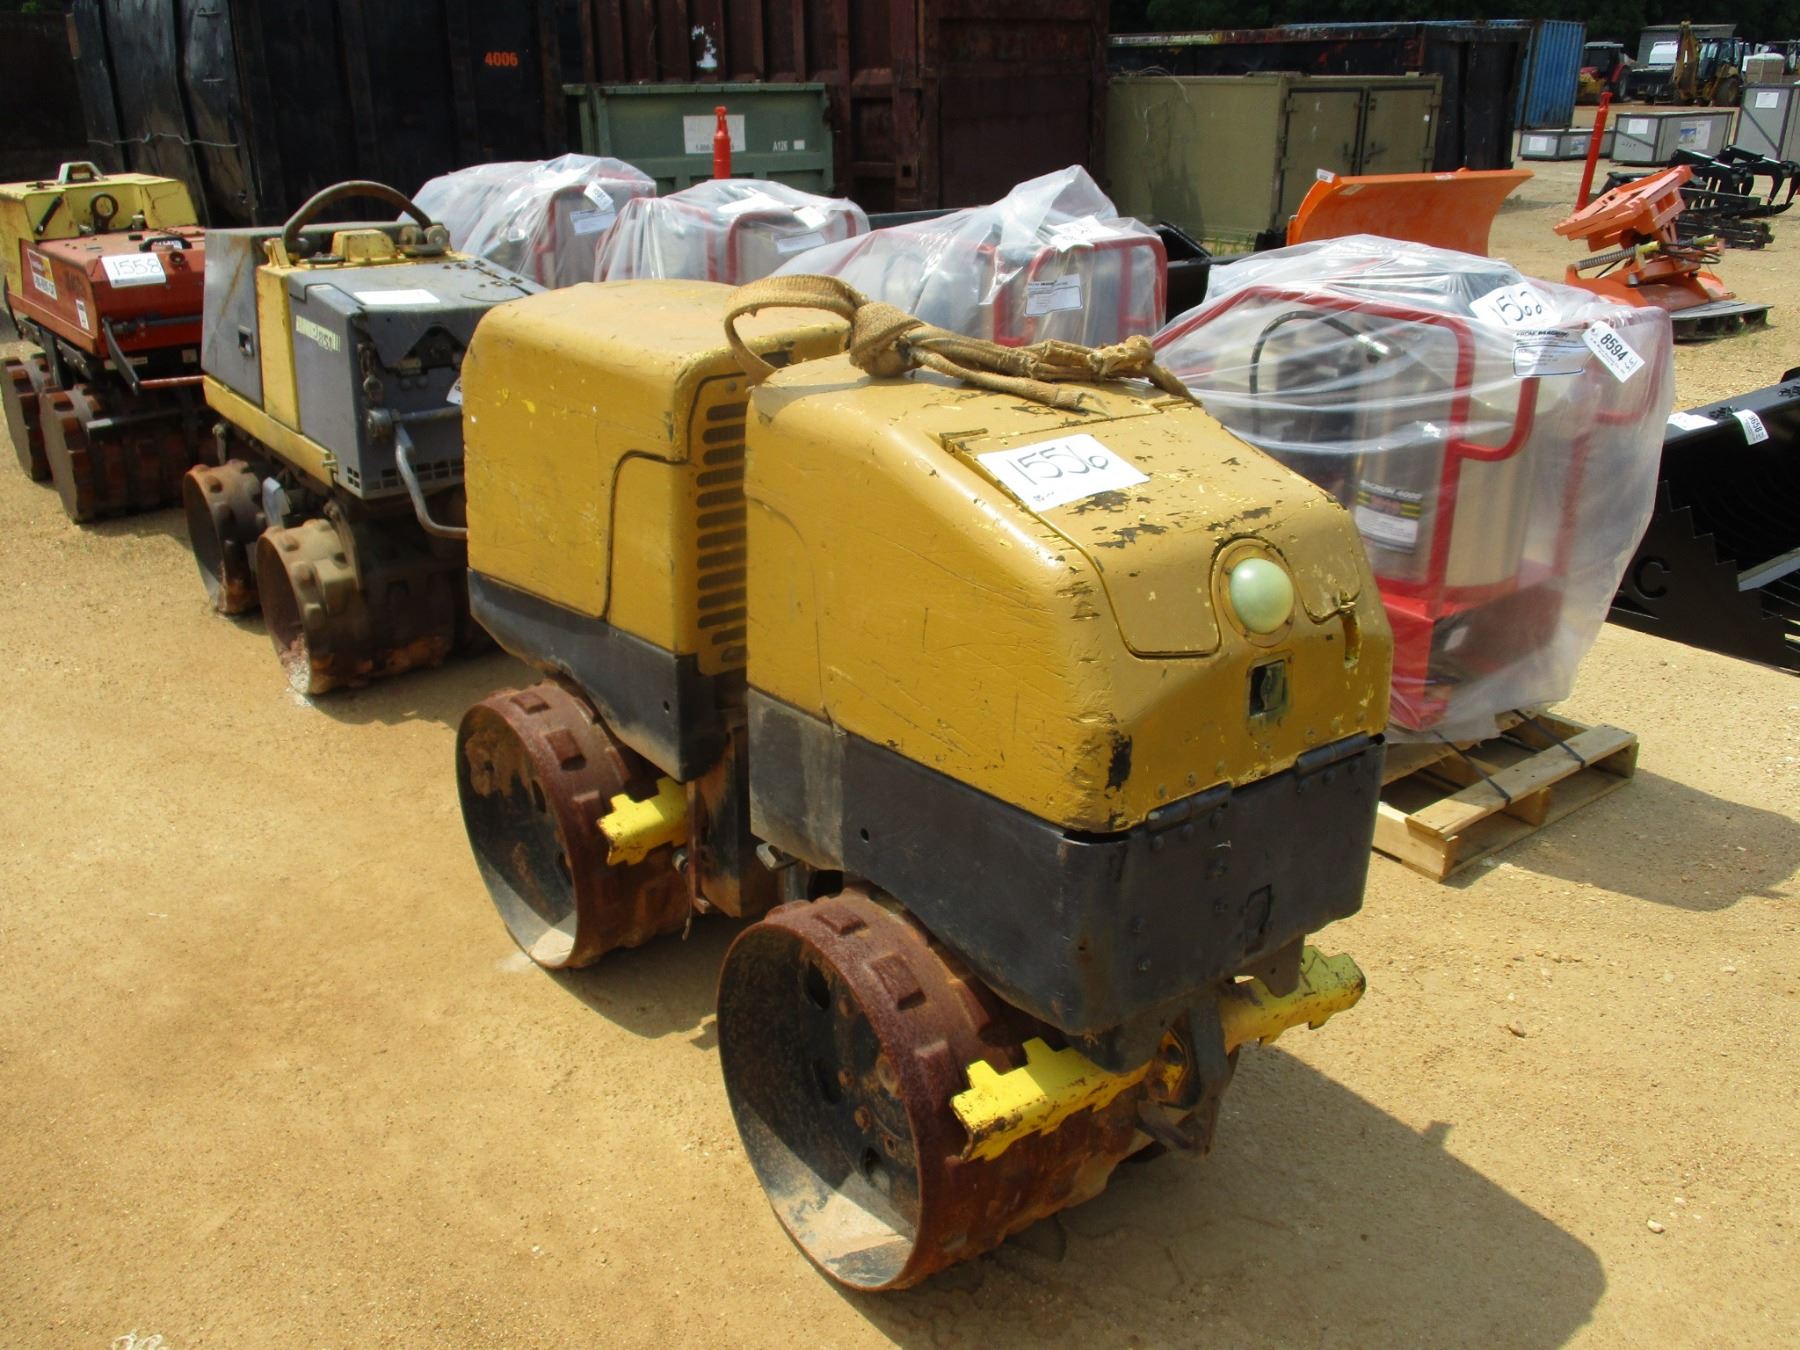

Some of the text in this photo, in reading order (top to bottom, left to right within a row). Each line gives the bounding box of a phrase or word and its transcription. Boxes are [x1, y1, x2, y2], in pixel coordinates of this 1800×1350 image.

[484, 51, 518, 67] 4006
[112, 258, 162, 276] 1558
[1600, 333, 1628, 361] 8594
[1006, 444, 1109, 486] 1556
